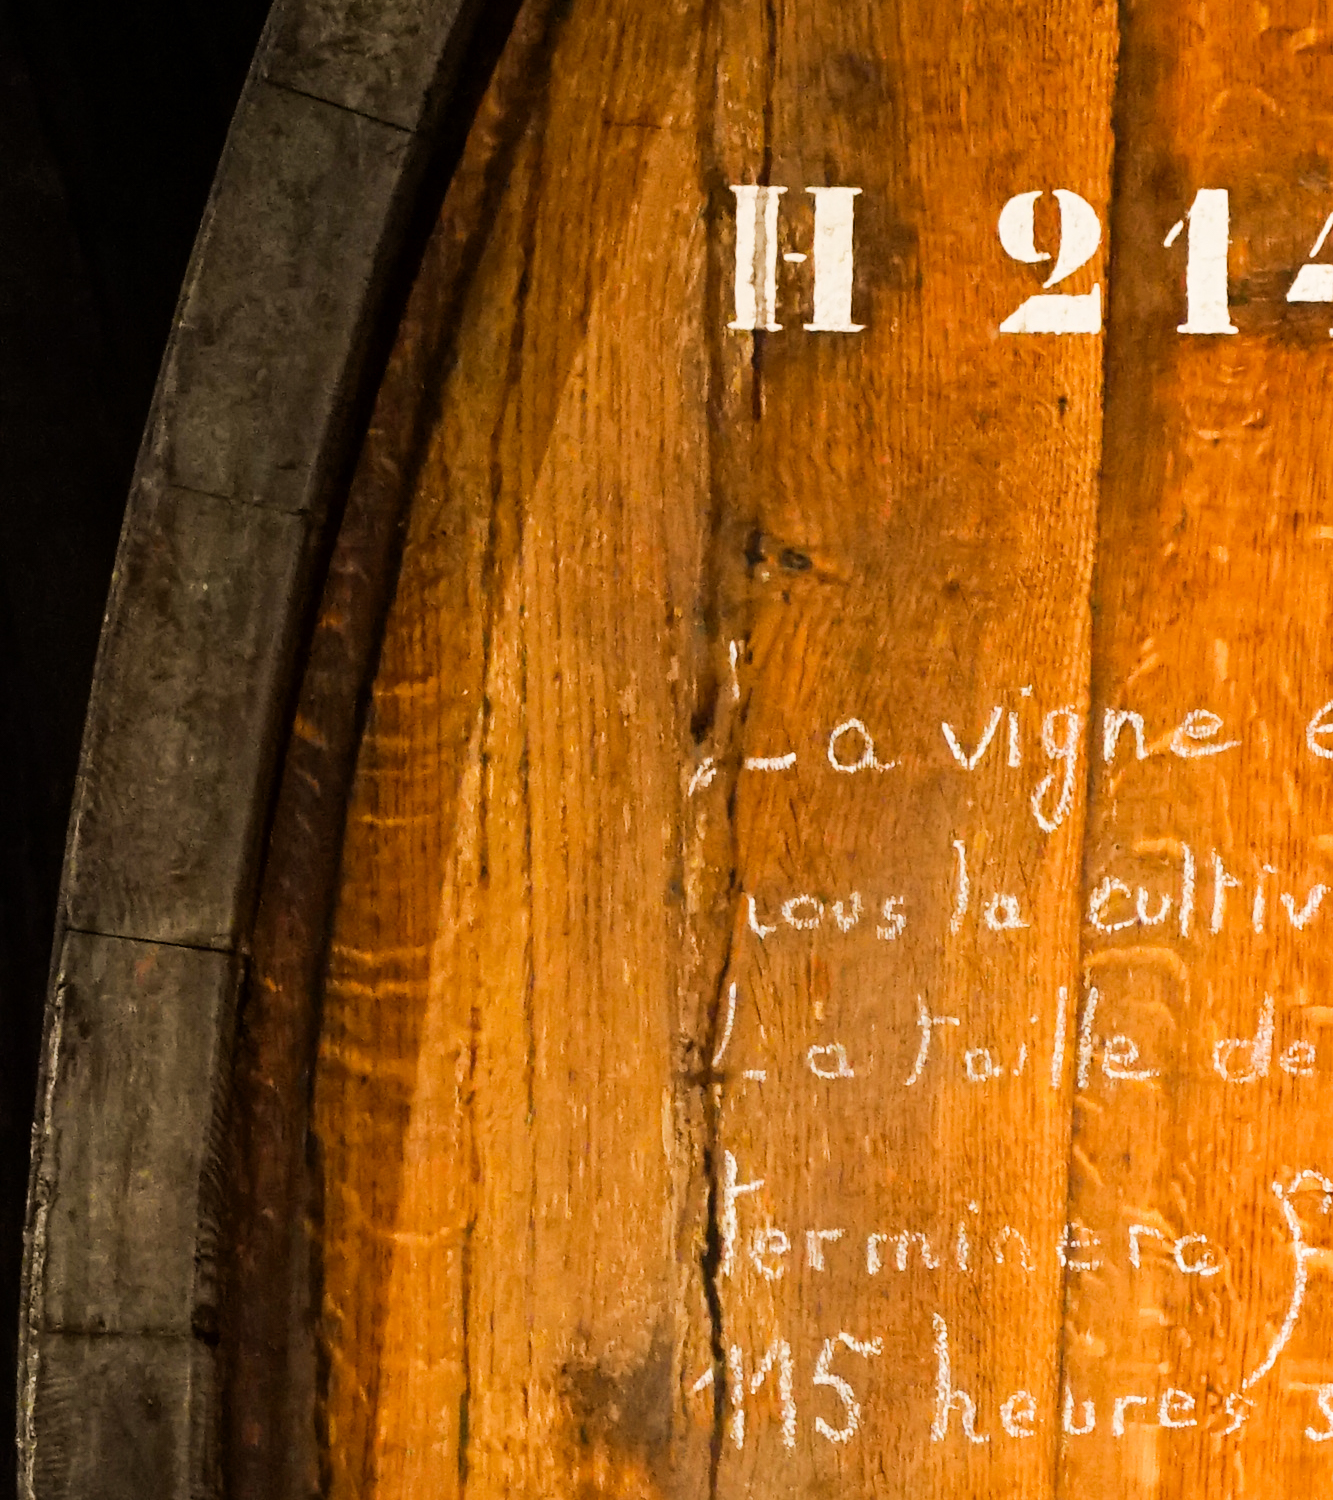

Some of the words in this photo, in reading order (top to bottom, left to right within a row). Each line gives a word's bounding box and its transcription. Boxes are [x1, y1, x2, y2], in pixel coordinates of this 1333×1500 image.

[727, 185, 866, 333] H
[941, 683, 1241, 833] vigne
[950, 839, 1030, 936] la
[905, 986, 1160, 1090] taille
[1212, 992, 1316, 1084] de
[931, 1312, 1255, 1444] heures
